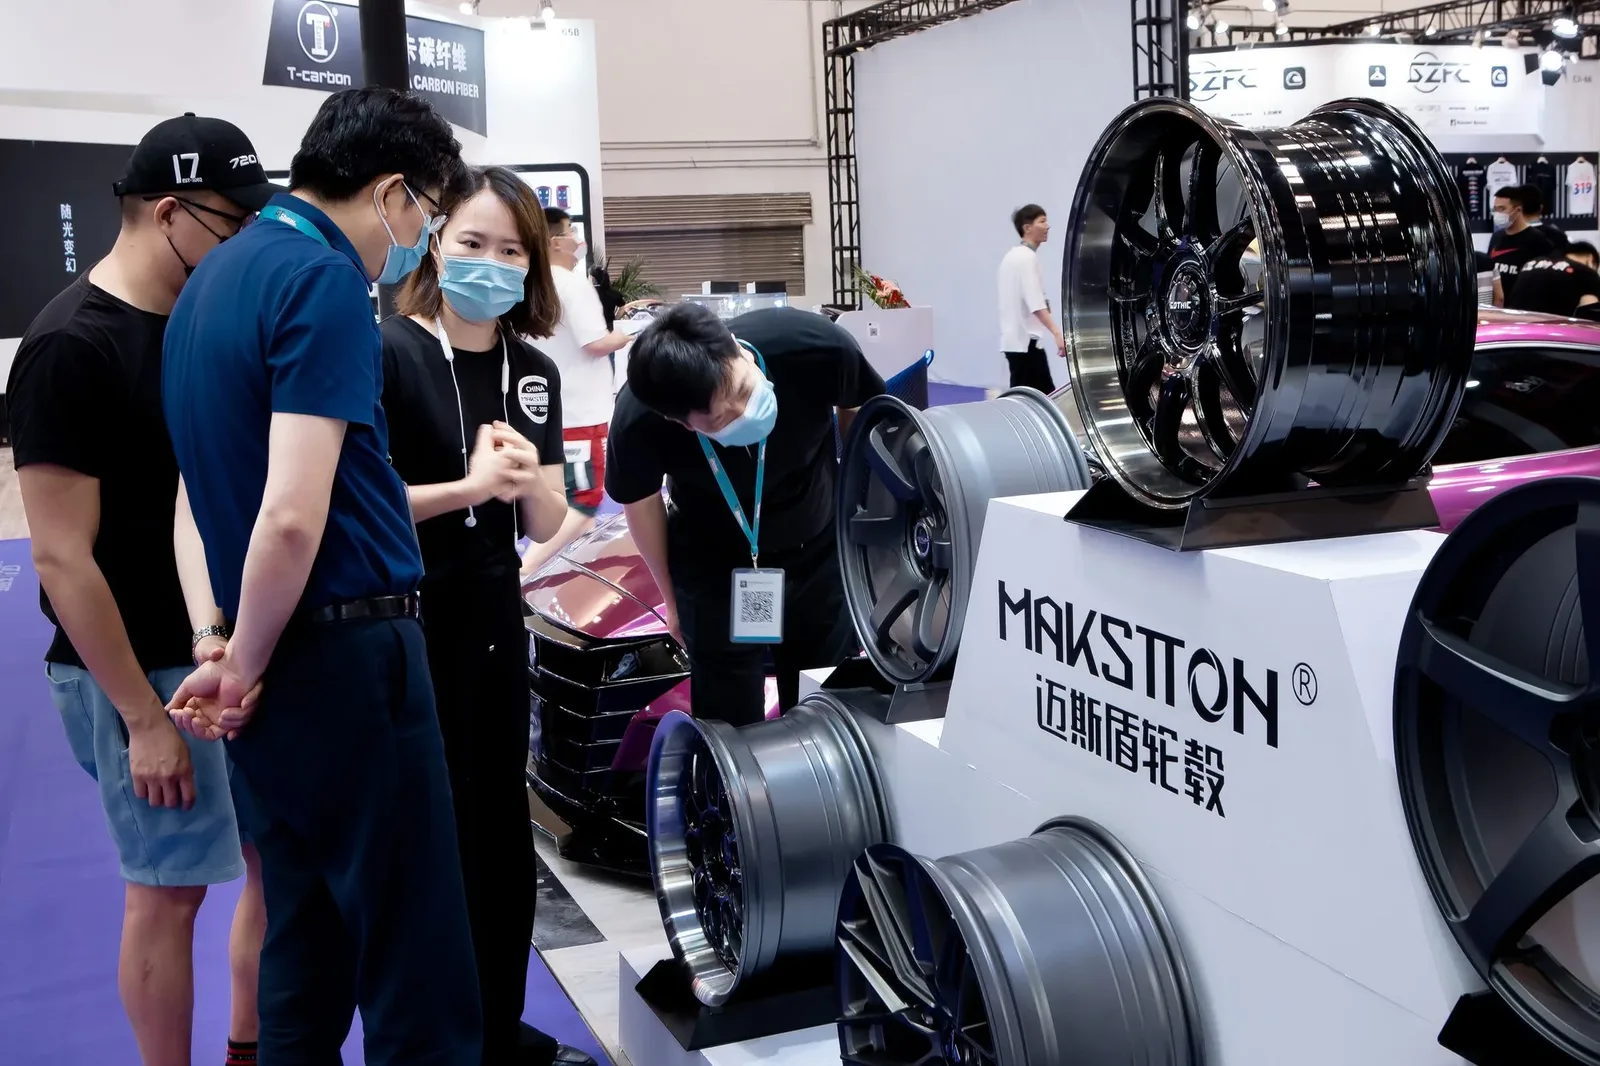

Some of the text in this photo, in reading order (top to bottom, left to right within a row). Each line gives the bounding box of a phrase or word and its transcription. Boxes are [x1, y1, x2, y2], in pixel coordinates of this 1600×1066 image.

[286, 66, 352, 86] T-carbon
[413, 74, 455, 95] CARBON
[455, 81, 479, 99] FIBER
[172, 152, 200, 185] 17
[229, 154, 261, 170] 720
[1573, 182, 1593, 195] 319
[60, 203, 77, 273] 随光变幻
[1169, 301, 1192, 310] GOTHIC
[525, 385, 546, 393] CHINA
[998, 579, 1278, 749] MAKSTTON
[1036, 673, 1226, 819] 迈斯盾轮毂
